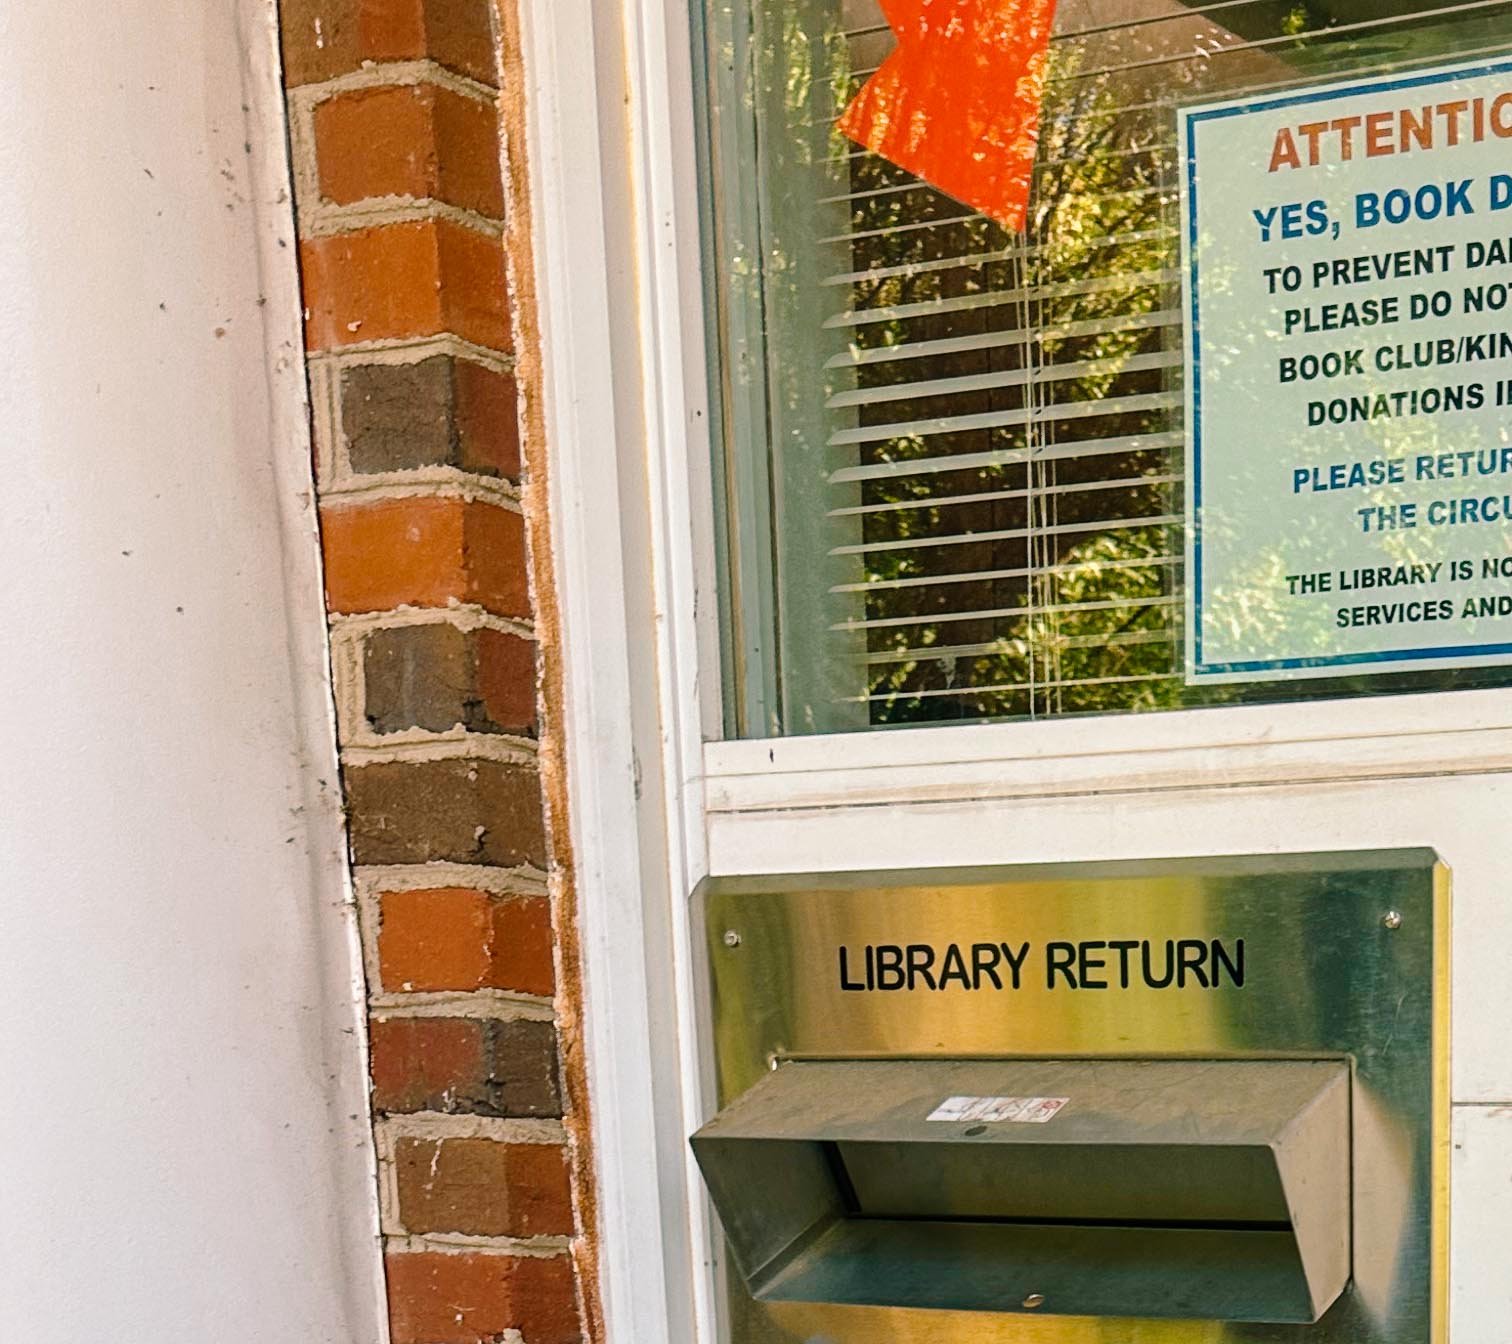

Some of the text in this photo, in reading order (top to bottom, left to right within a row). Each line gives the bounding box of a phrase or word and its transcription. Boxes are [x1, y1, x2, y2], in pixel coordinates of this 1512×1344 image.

[1252, 199, 1340, 243] YES,
[1355, 178, 1475, 229] BOOK
[1262, 265, 1302, 295] TO
[1312, 244, 1456, 289] PREVENT
[1284, 296, 1400, 336] PLEASE
[1409, 290, 1452, 321] DO
[1279, 348, 1365, 384] BOOK
[1307, 382, 1485, 427] DONATIONS
[1293, 458, 1405, 494] PLEASE
[1357, 503, 1417, 533] THE
[1284, 571, 1332, 596] THE
[1339, 562, 1443, 591] LIBRARY
[1450, 559, 1474, 582] IS
[1336, 599, 1454, 629] SERVICES
[839, 939, 1245, 991] LIBRARY RETURN
